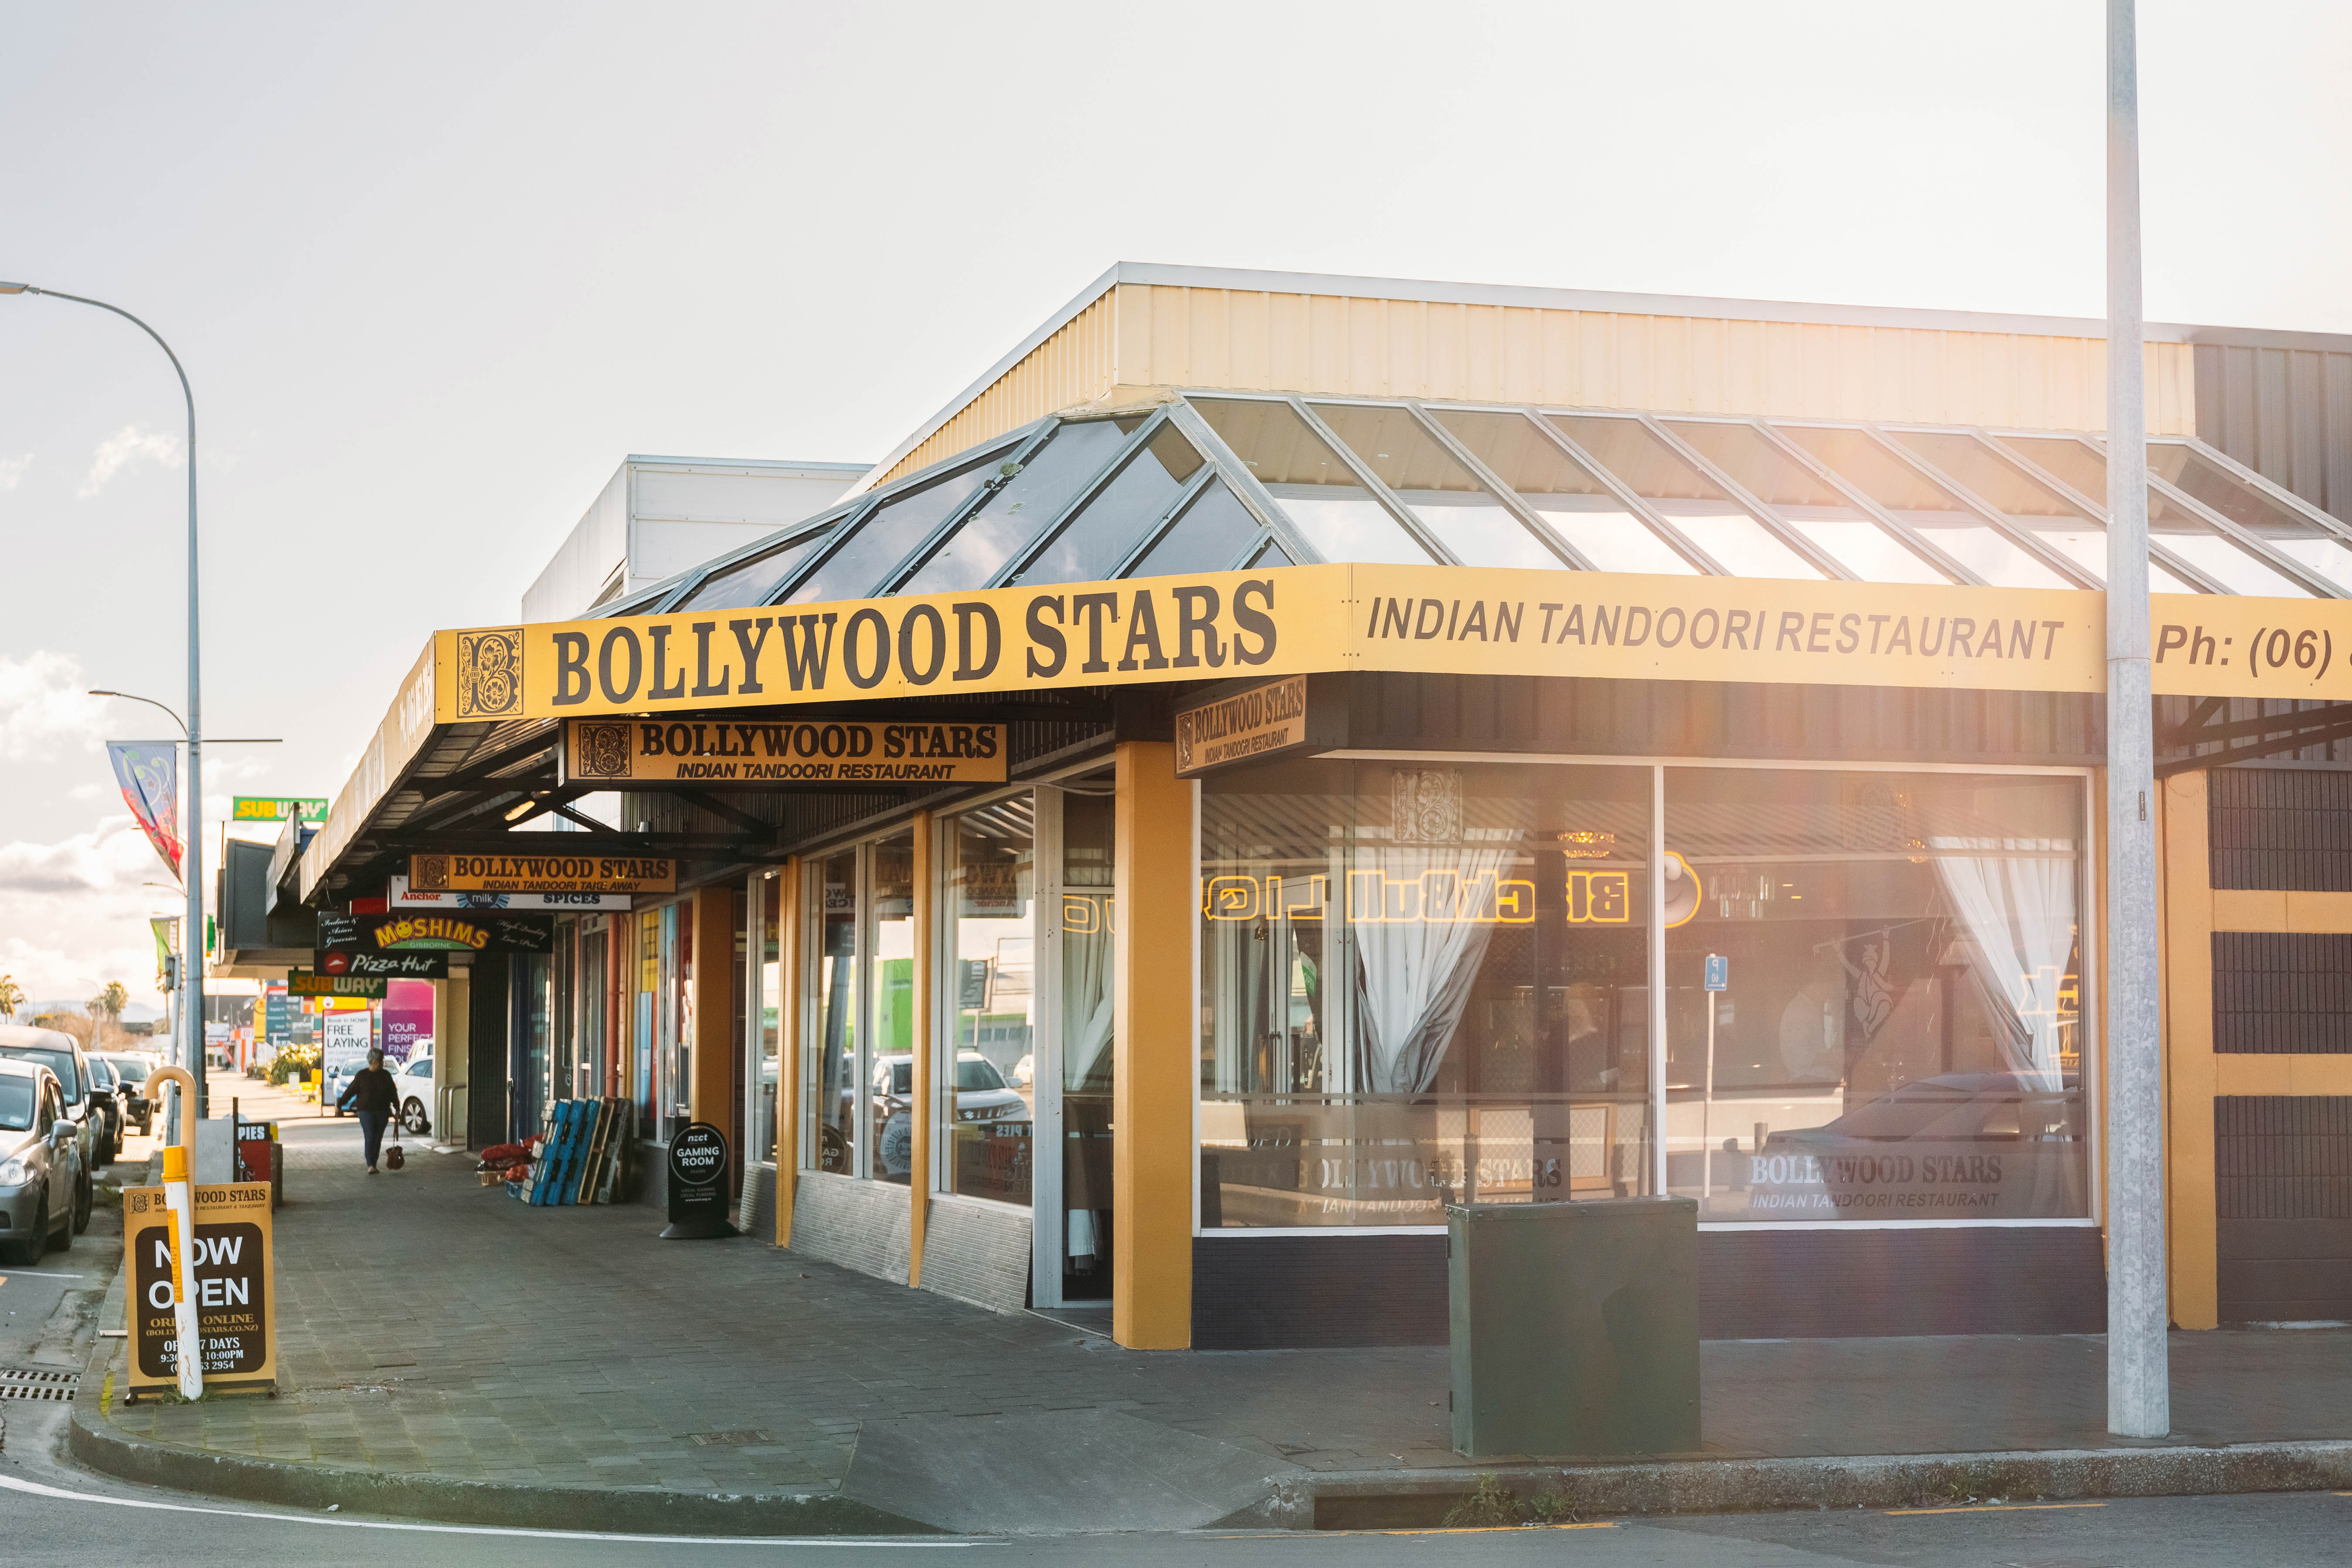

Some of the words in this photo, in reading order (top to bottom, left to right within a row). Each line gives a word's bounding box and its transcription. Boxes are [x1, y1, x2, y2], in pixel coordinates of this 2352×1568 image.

[553, 602, 1001, 706] BOLLYWOOD
[1026, 580, 1277, 678] STARS
[1367, 597, 1523, 642] INDIAN
[1537, 603, 1765, 650] TANDOORI
[1778, 611, 2063, 659] RESTAURANT
[2155, 625, 2232, 665] Ph:
[2250, 628, 2332, 680] (06)
[1195, 693, 1262, 744] BOLLYWOOD
[1266, 679, 1304, 725] STARS
[640, 724, 872, 757] BOLLYWOOD
[884, 725, 997, 759] STARS
[1205, 746, 1221, 763] INDIAN
[1224, 741, 1250, 758] TANDOORI
[1251, 728, 1288, 752] RESTAURANT
[676, 762, 736, 778] INDIAN
[744, 763, 833, 779] TANDOORI
[838, 764, 955, 779] RESTAURANT
[454, 857, 594, 878] BOLLYWOOD
[600, 859, 669, 879] STARS
[483, 880, 521, 889] INDIAN
[523, 881, 577, 890] TANDOORI
[580, 881, 607, 891] TAKE
[610, 881, 641, 891] AWAY
[402, 891, 441, 901] Anchor
[472, 893, 492, 902] milk
[543, 894, 600, 904] SPICES
[321, 918, 349, 926] Indian
[375, 917, 491, 950] MOSHIMS
[352, 954, 399, 973] Pizza
[401, 955, 437, 972] Hut
[292, 976, 383, 993] SUBWAY
[327, 1025, 353, 1035] FREE
[388, 1023, 416, 1032] YOUR
[327, 1038, 368, 1047] LAYING
[388, 1044, 410, 1053] FINIS
[238, 1126, 265, 1140] PIES
[688, 1134, 708, 1142] nzct
[677, 1147, 719, 1157] GAMING
[682, 1157, 714, 1166] ROOM
[1479, 1158, 1562, 1188] STARS
[1751, 1155, 1914, 1184] BOLLYWOOD
[1922, 1154, 2002, 1184] STARS
[230, 1189, 266, 1202] STARS
[1753, 1194, 1806, 1208] INDIAN
[1812, 1194, 1893, 1208] TANDOORI
[1897, 1193, 1999, 1206] RESTAURANT
[155, 1237, 242, 1267] NOW
[203, 1314, 254, 1325] ONLINE
[200, 1339, 206, 1349] 7
[210, 1337, 240, 1349] DAYS
[206, 1350, 244, 1360] 10:00PM
[212, 1360, 234, 1370] 2954
